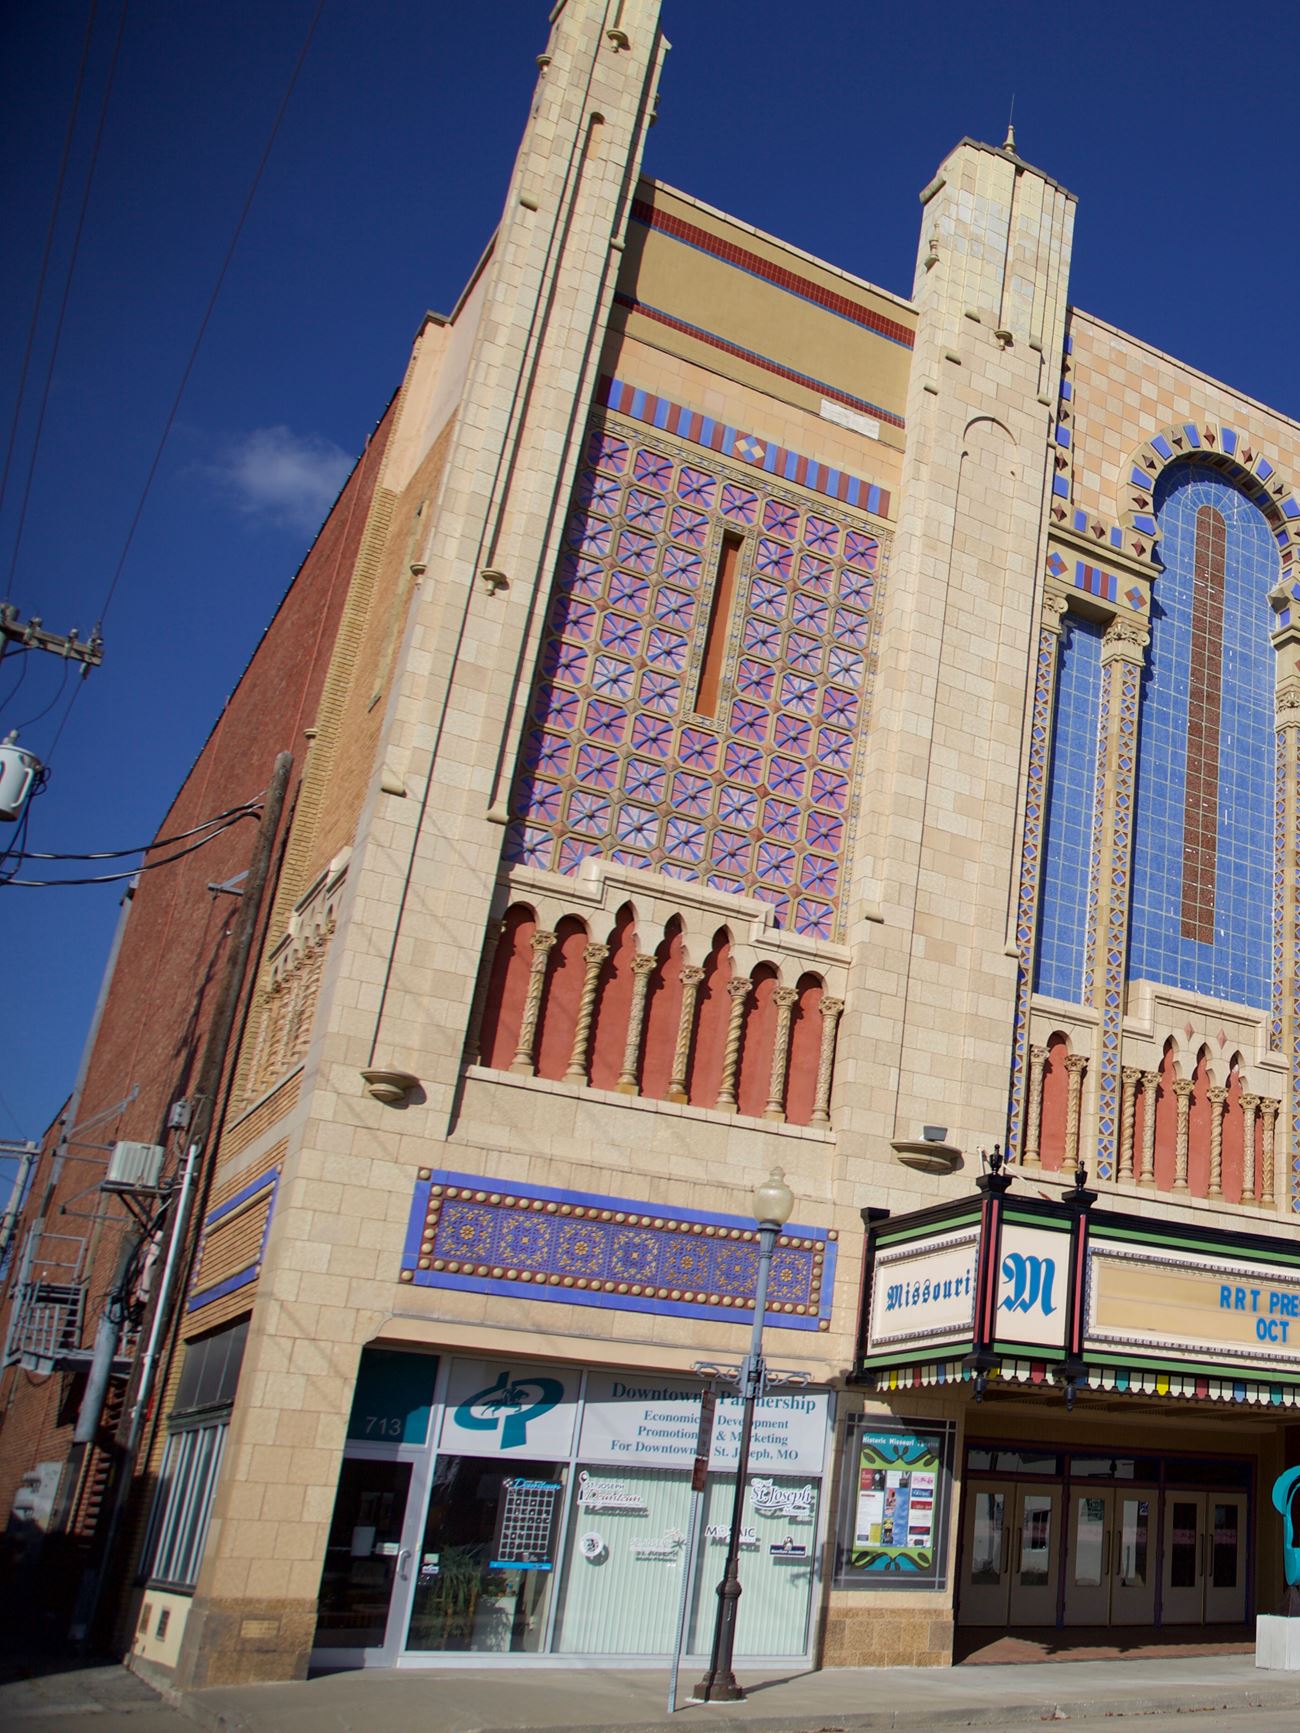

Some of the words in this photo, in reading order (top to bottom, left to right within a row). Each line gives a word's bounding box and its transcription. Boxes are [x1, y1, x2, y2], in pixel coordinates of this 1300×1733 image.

[885, 1268, 971, 1312] Missouri
[997, 1252, 1057, 1316] M
[1256, 1318, 1290, 1343] OCT
[611, 1381, 703, 1404] Downtown
[719, 1390, 816, 1414] Parnership
[365, 1416, 401, 1436] 713
[644, 1410, 700, 1425] Economic
[717, 1415, 789, 1431] Devepment
[637, 1425, 698, 1441] Promotion
[716, 1431, 726, 1441] &
[611, 1439, 632, 1451] For
[635, 1441, 698, 1456] Downtown
[714, 1446, 729, 1458] St.
[777, 1449, 799, 1461] MO
[767, 1485, 812, 1505] Joseph
